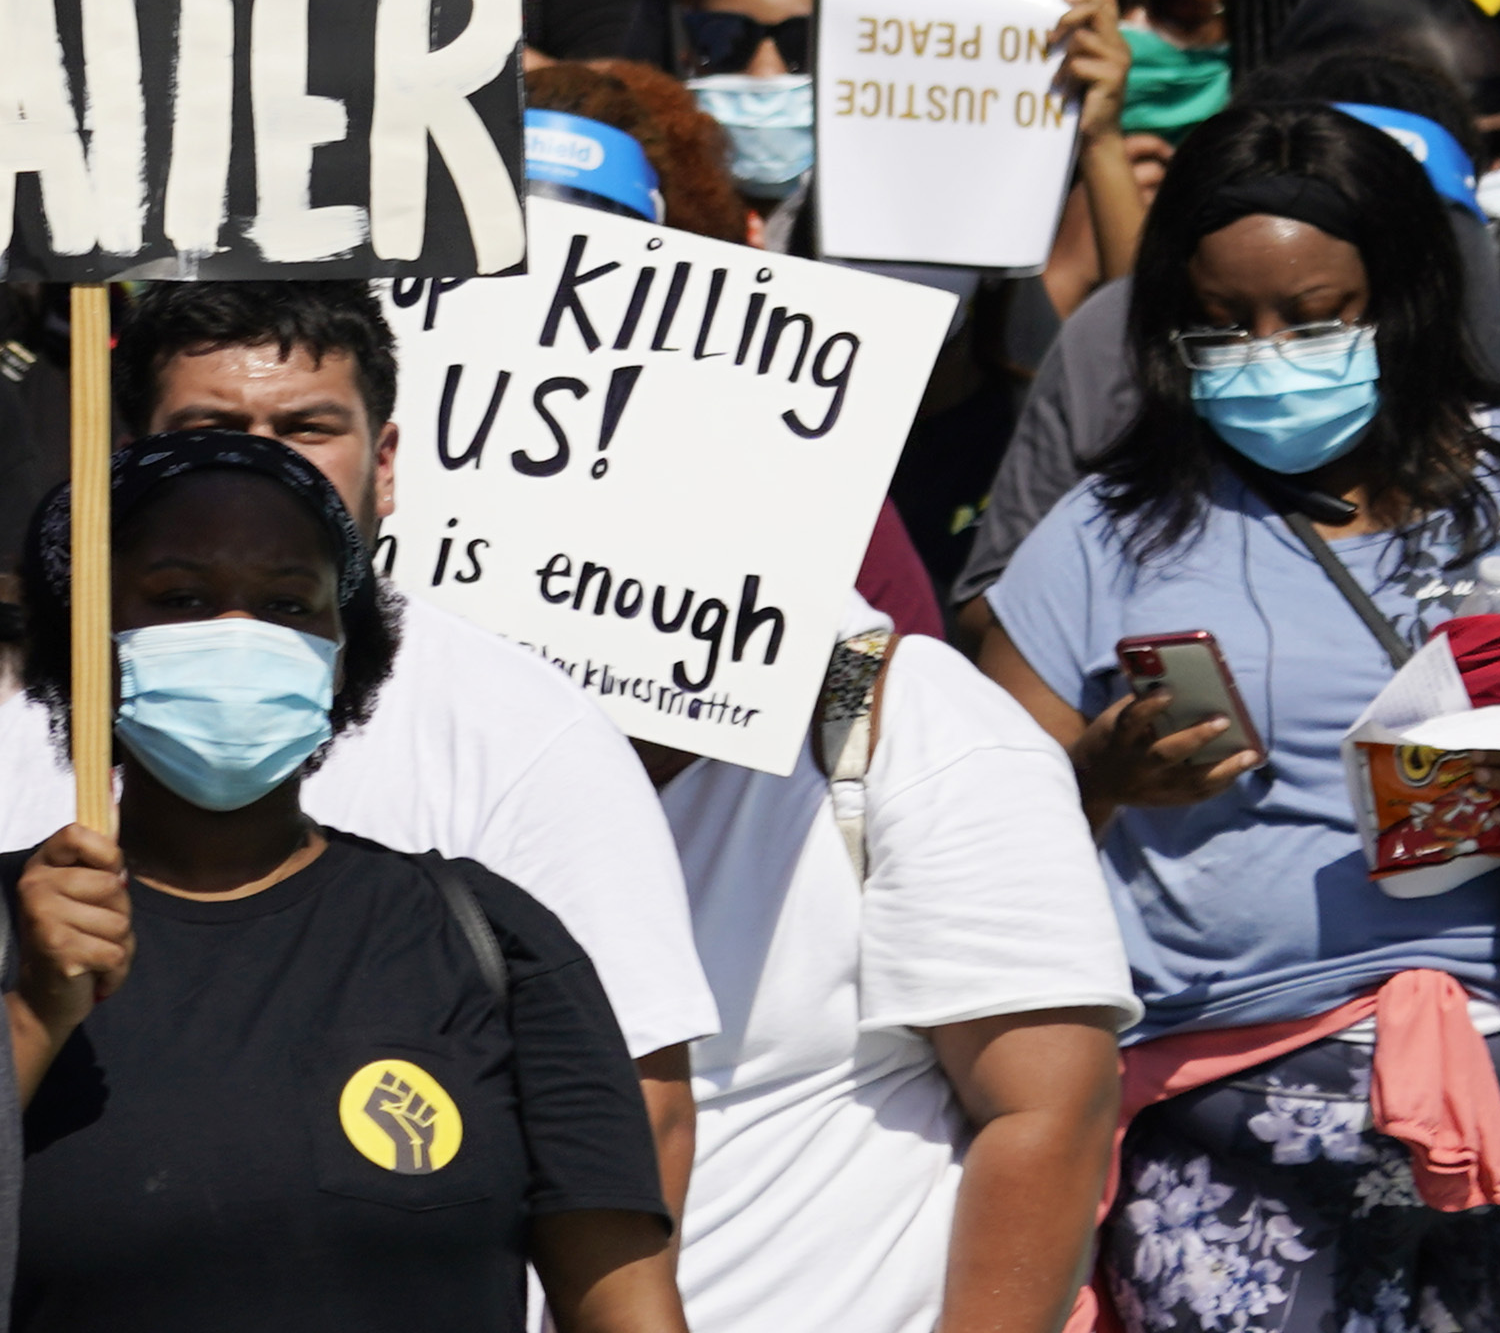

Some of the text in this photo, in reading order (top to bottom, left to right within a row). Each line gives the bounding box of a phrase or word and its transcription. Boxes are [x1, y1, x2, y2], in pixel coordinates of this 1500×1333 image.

[857, 15, 1050, 66] NO PEACE
[836, 78, 1065, 131] NO JUSTICE
[528, 133, 592, 161] hield
[430, 517, 491, 588] is
[536, 553, 786, 694] enough
